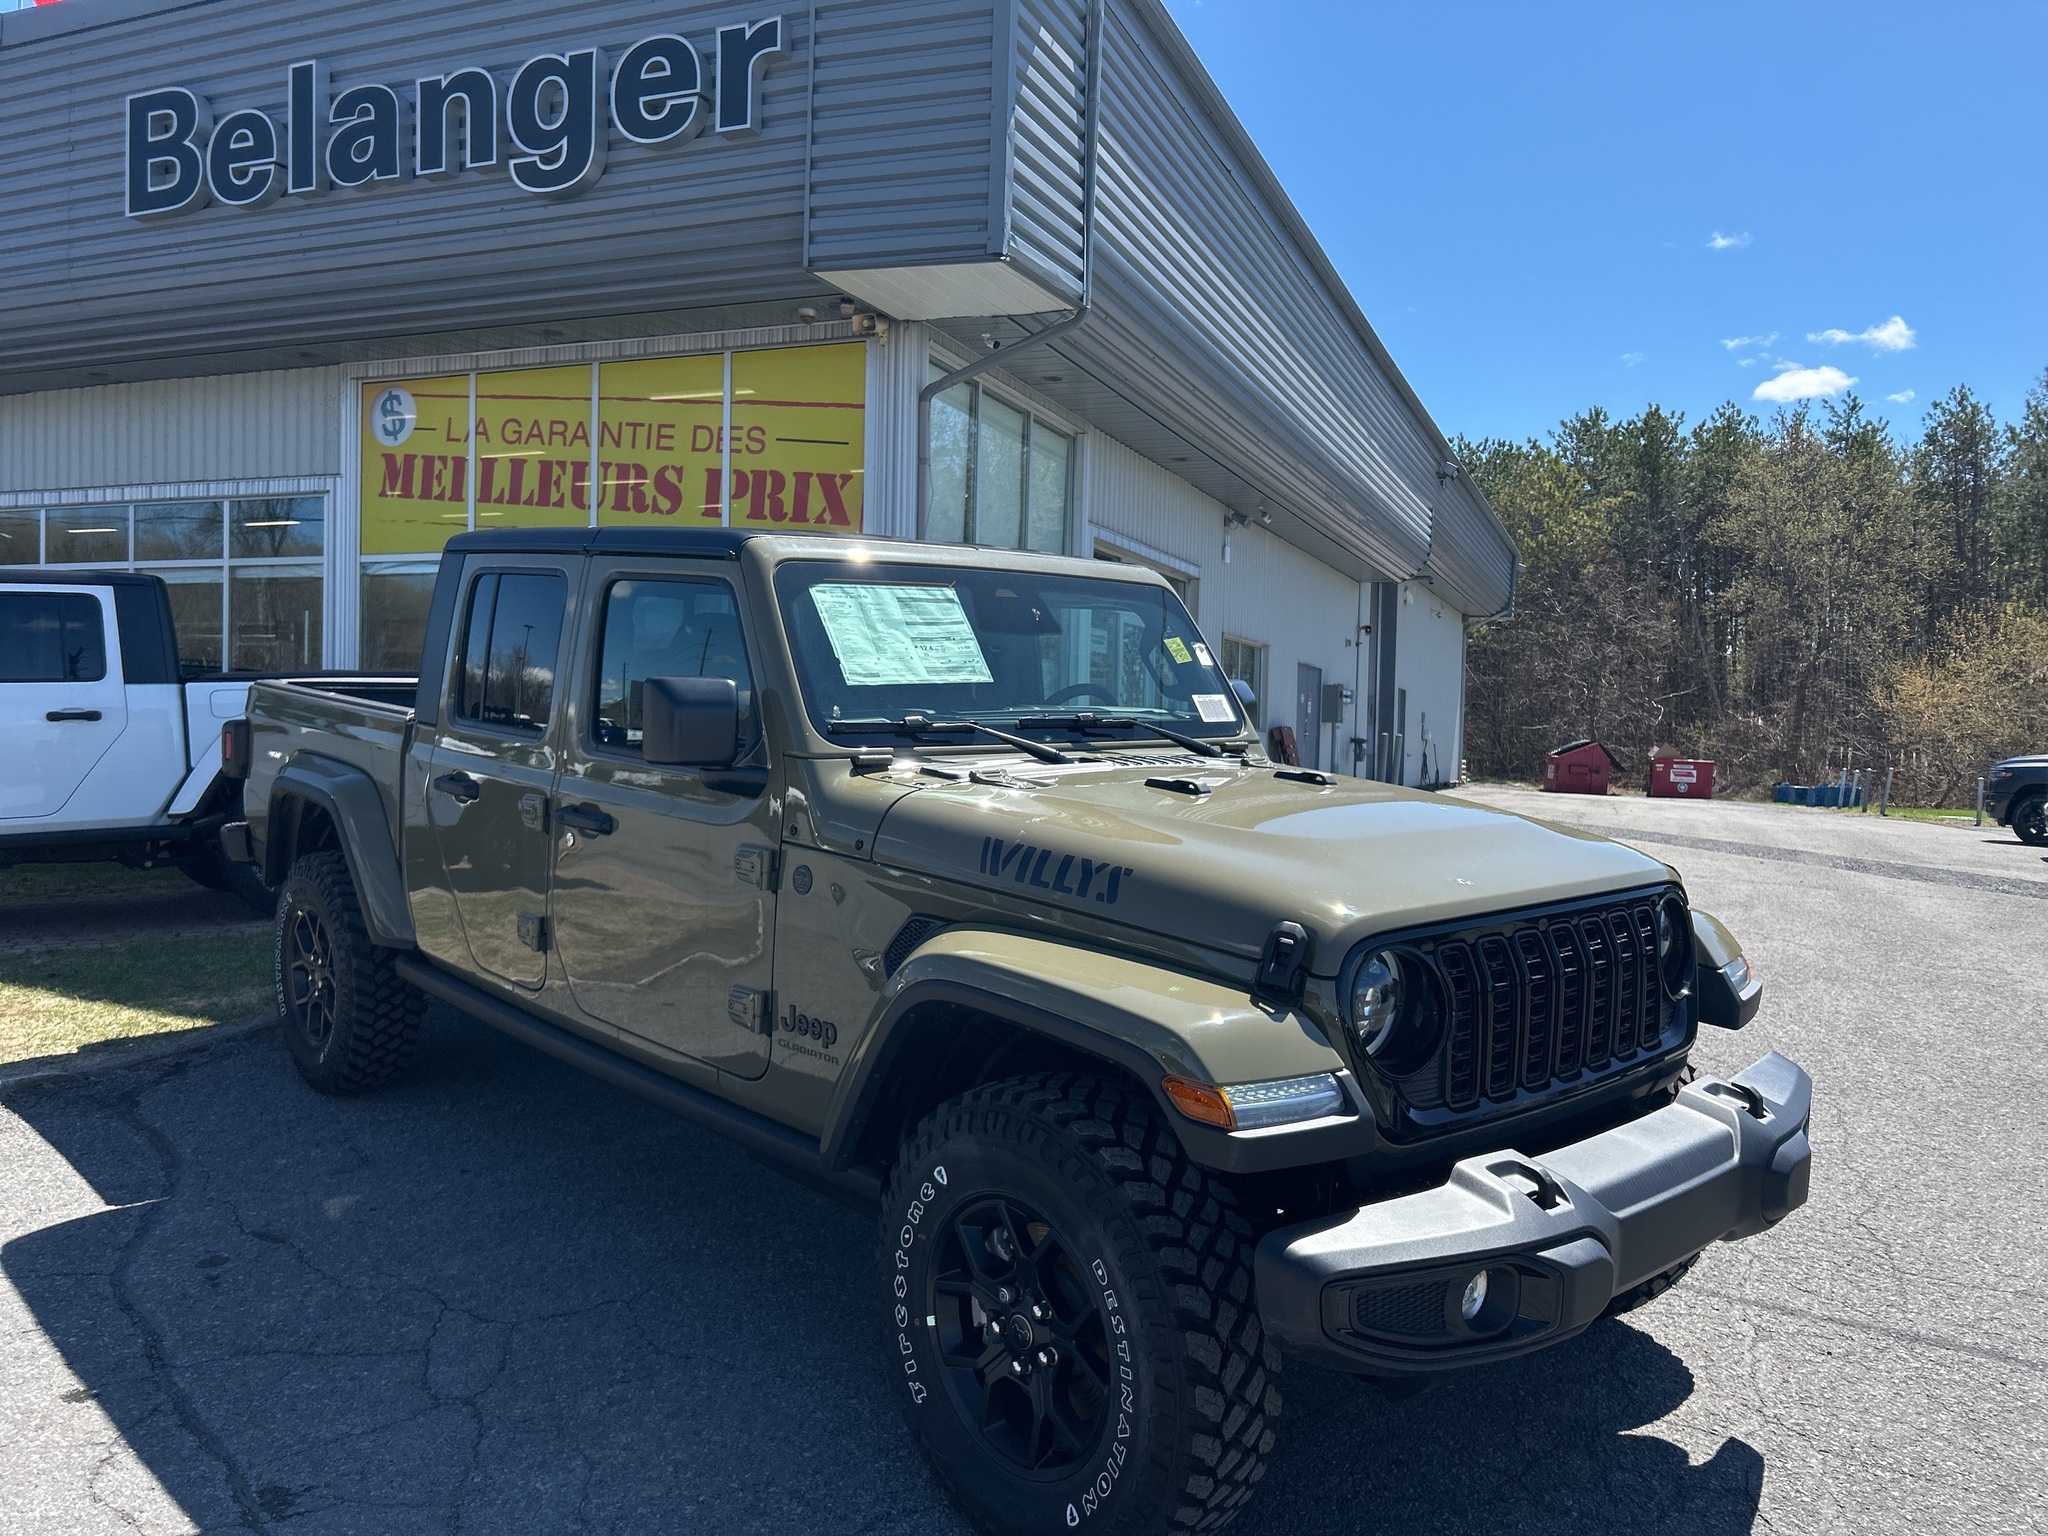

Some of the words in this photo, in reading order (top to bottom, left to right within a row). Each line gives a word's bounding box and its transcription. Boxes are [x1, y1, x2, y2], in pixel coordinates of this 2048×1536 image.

[125, 15, 786, 218] Belanger
[445, 416, 490, 444] LA
[501, 417, 676, 452] GARANTIE
[691, 425, 766, 455] DES
[378, 452, 684, 516] MEILLEURS
[701, 467, 854, 527] PRIX
[979, 836, 1134, 905] WILLYS
[778, 1038, 840, 1066] GLADIATOR
[780, 1004, 838, 1049] Jeep
[1082, 1258, 1134, 1516] DESTINATION
